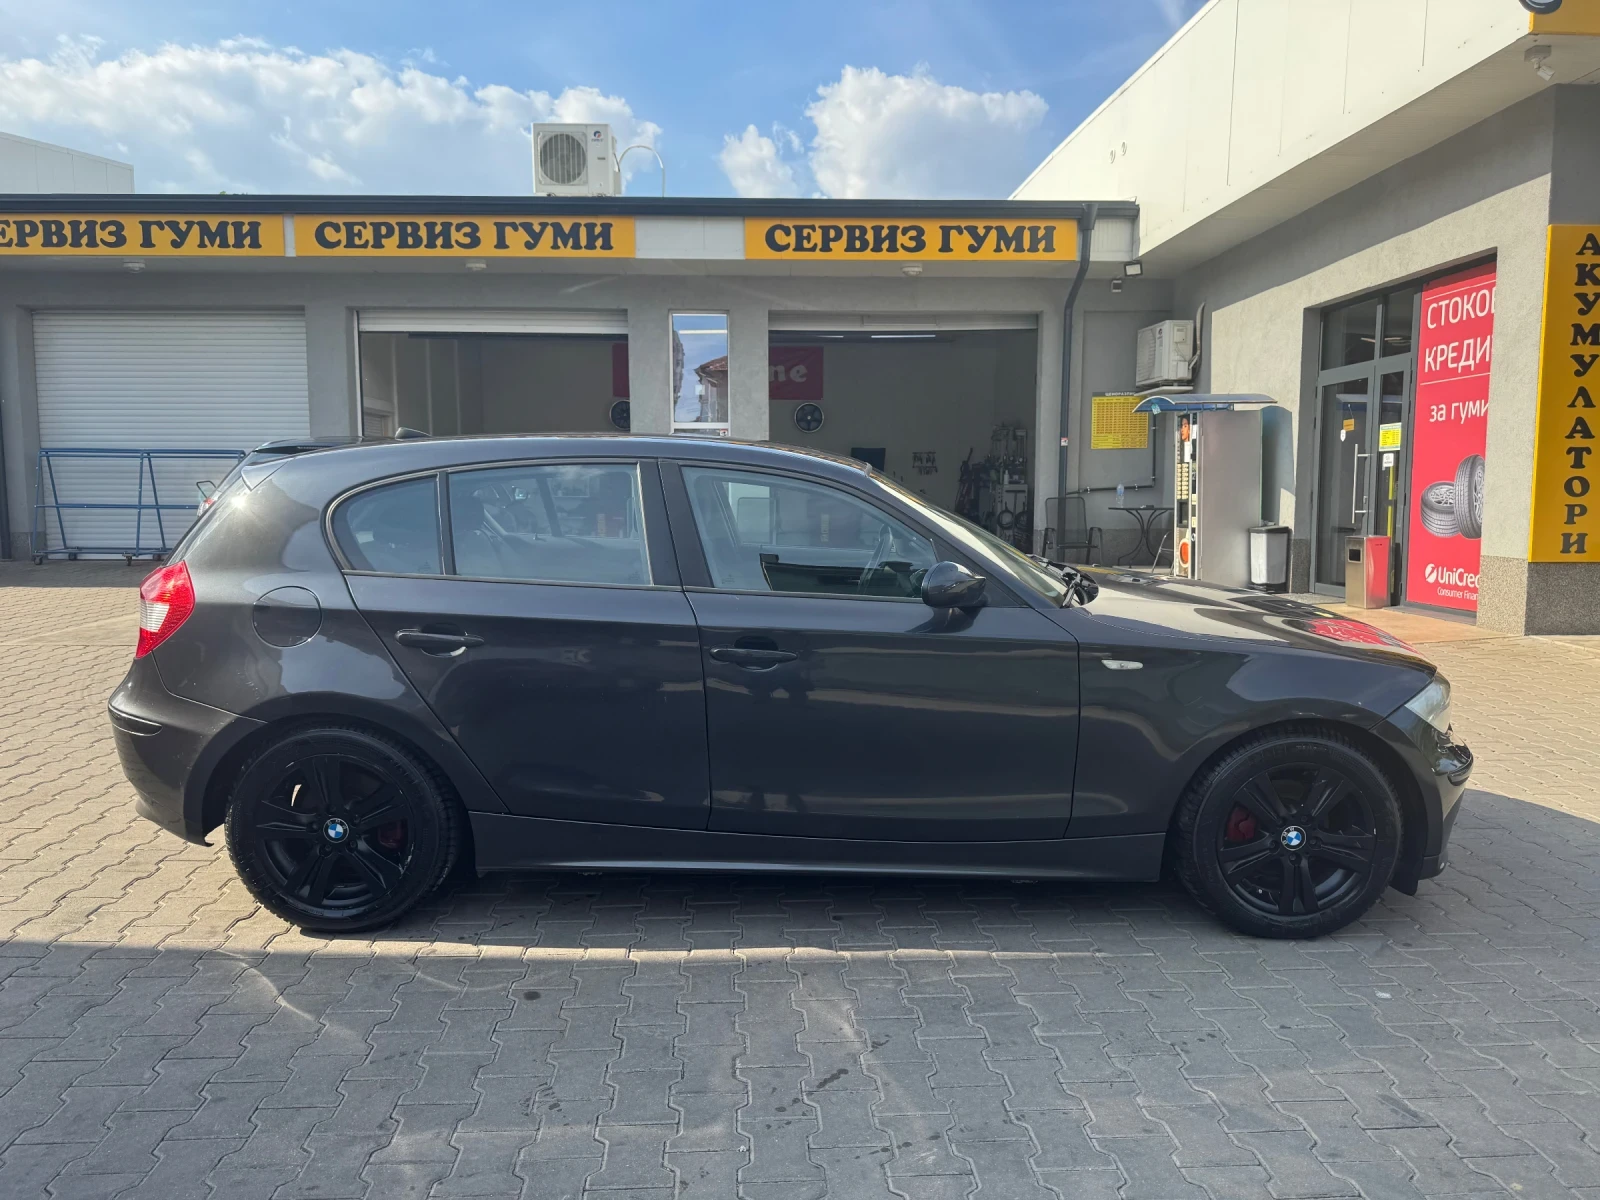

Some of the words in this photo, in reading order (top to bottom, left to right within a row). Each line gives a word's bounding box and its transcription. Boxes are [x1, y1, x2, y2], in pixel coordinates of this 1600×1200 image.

[138, 220, 262, 249] ГУМИ
[315, 221, 481, 249] СЕРВИЗ
[493, 222, 614, 250] ГУМИ
[765, 224, 926, 253] СЕРВИЗ
[938, 225, 1056, 253] ГУМИ
[1424, 335, 1493, 374] КРЕДИ
[1429, 404, 1446, 422] за
[1437, 587, 1463, 598] Consumer
